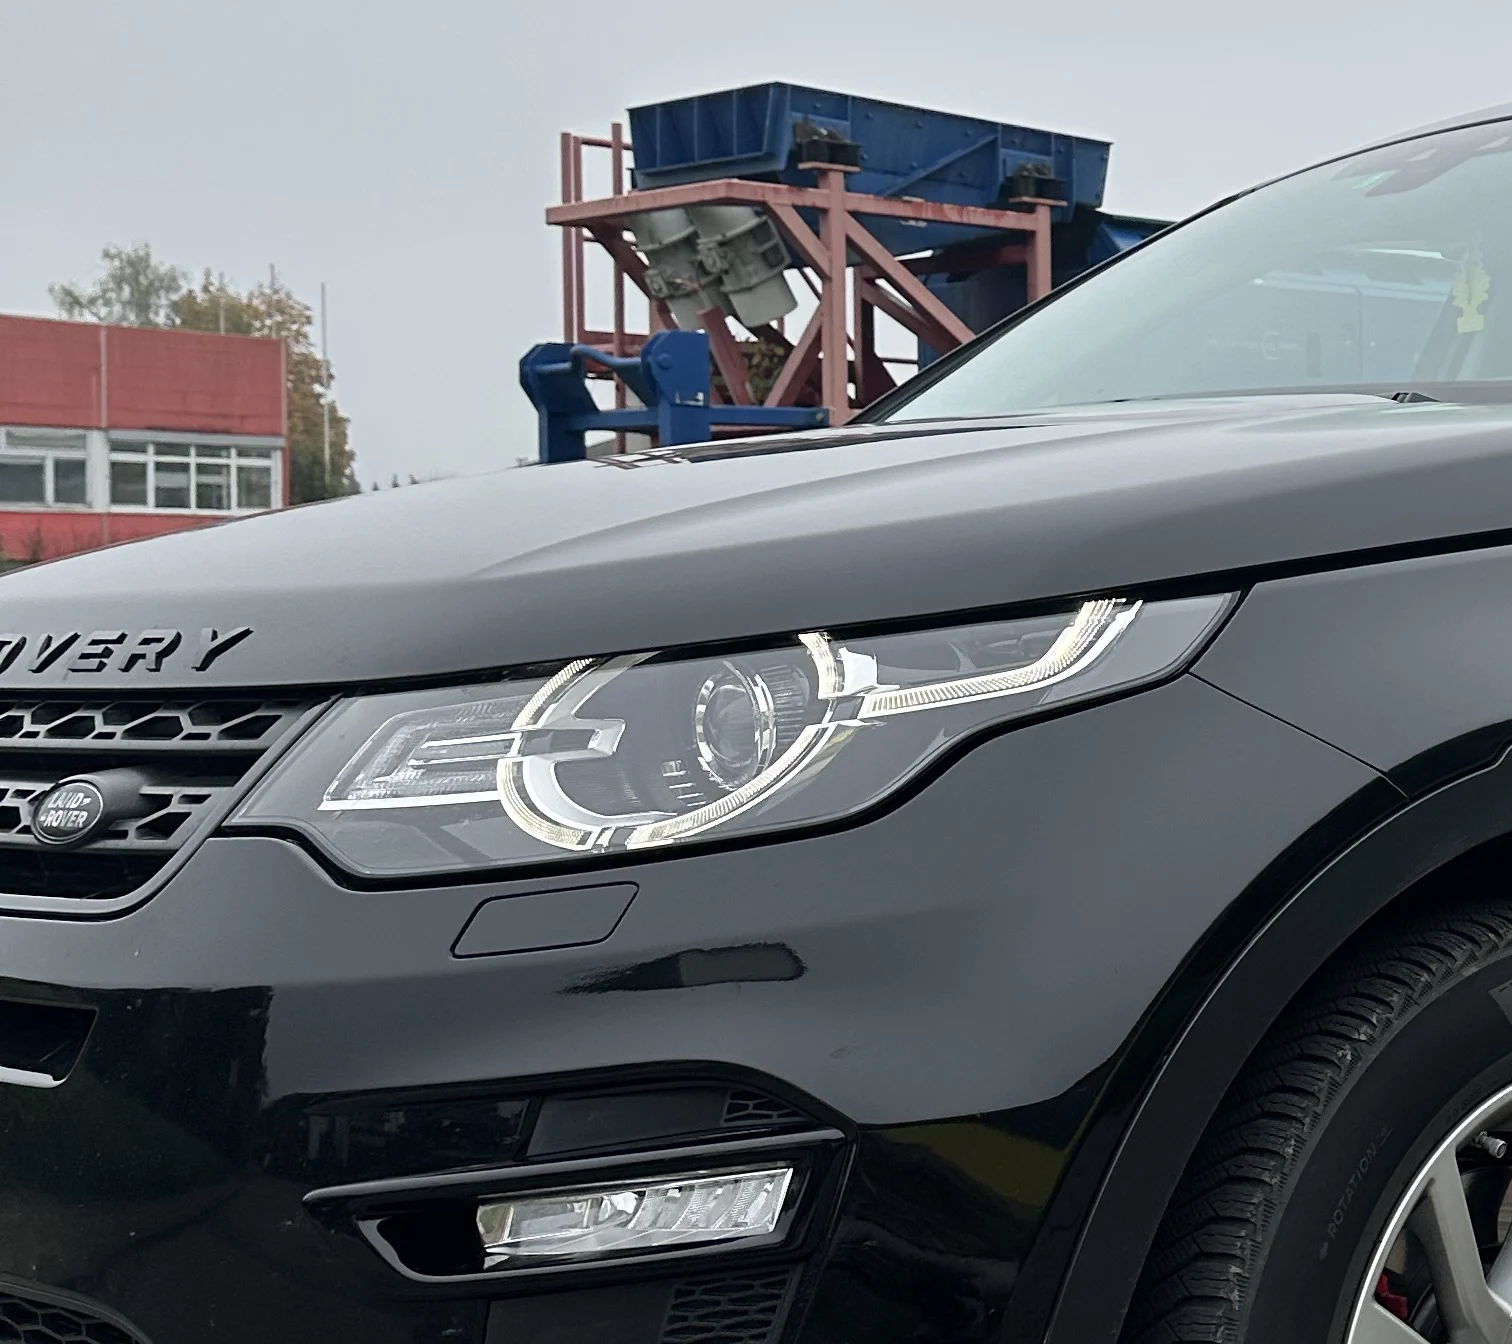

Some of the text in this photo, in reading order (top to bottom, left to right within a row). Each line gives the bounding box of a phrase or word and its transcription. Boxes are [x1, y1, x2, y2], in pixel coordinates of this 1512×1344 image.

[47, 791, 85, 809] LAND
[43, 810, 89, 828] ROVER
[1327, 1141, 1378, 1240] ROTATION
